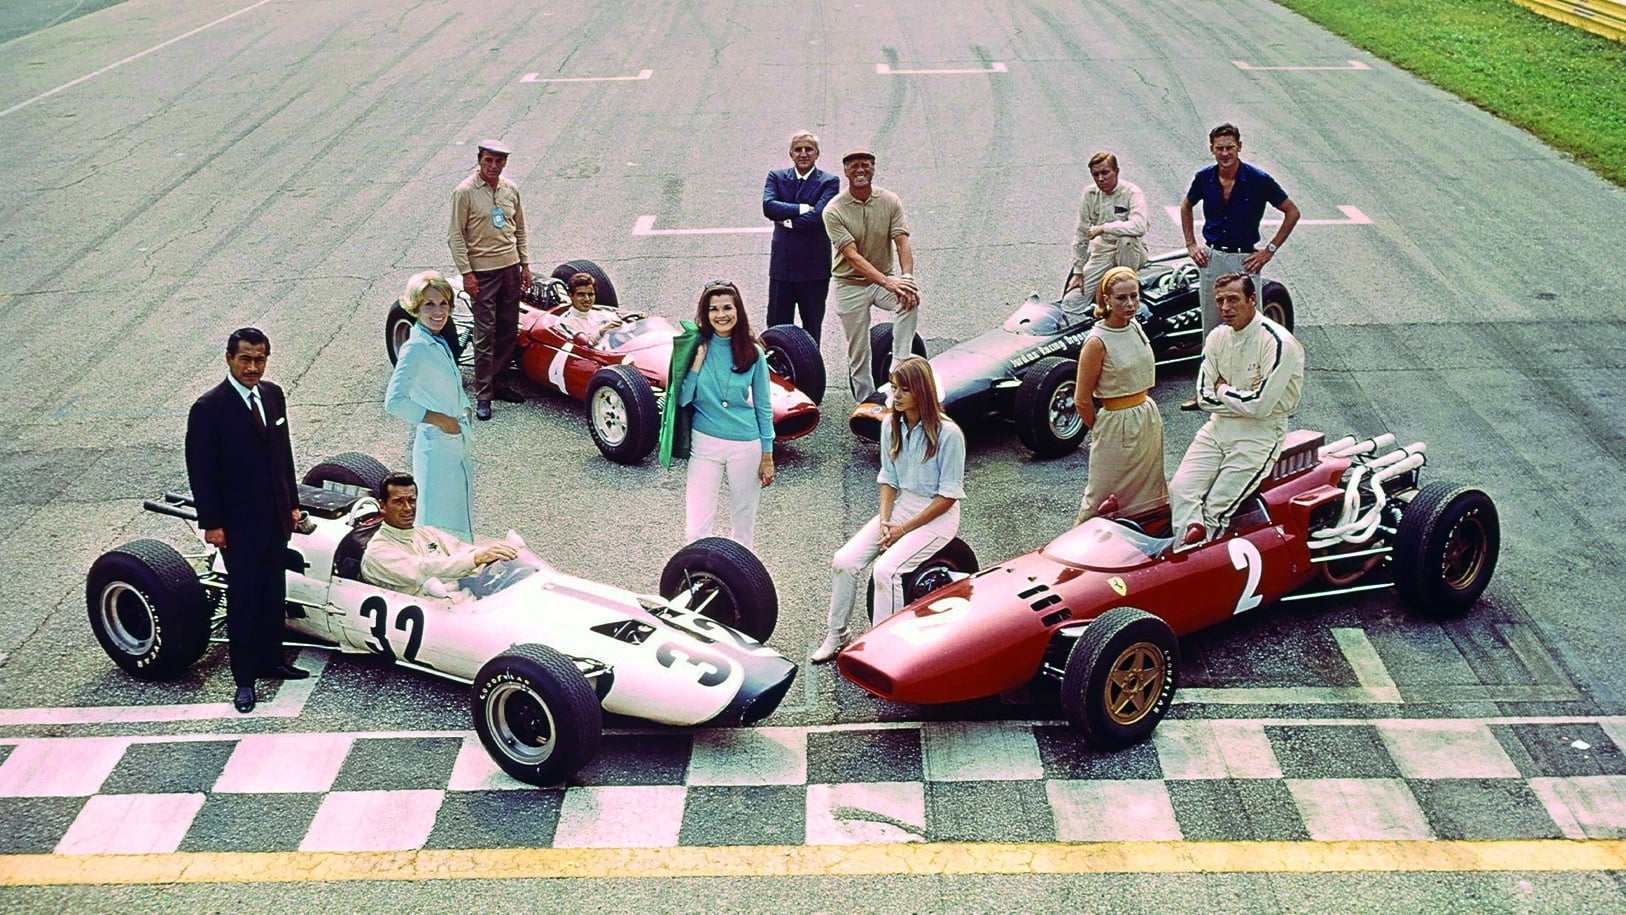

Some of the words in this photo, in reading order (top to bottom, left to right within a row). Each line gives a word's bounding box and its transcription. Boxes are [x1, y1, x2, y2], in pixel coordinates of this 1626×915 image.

[1010, 351, 1040, 367] Jordan
[1038, 341, 1067, 355] Racing
[1227, 537, 1264, 615] 2
[359, 595, 434, 669] 32
[889, 596, 973, 646] 2
